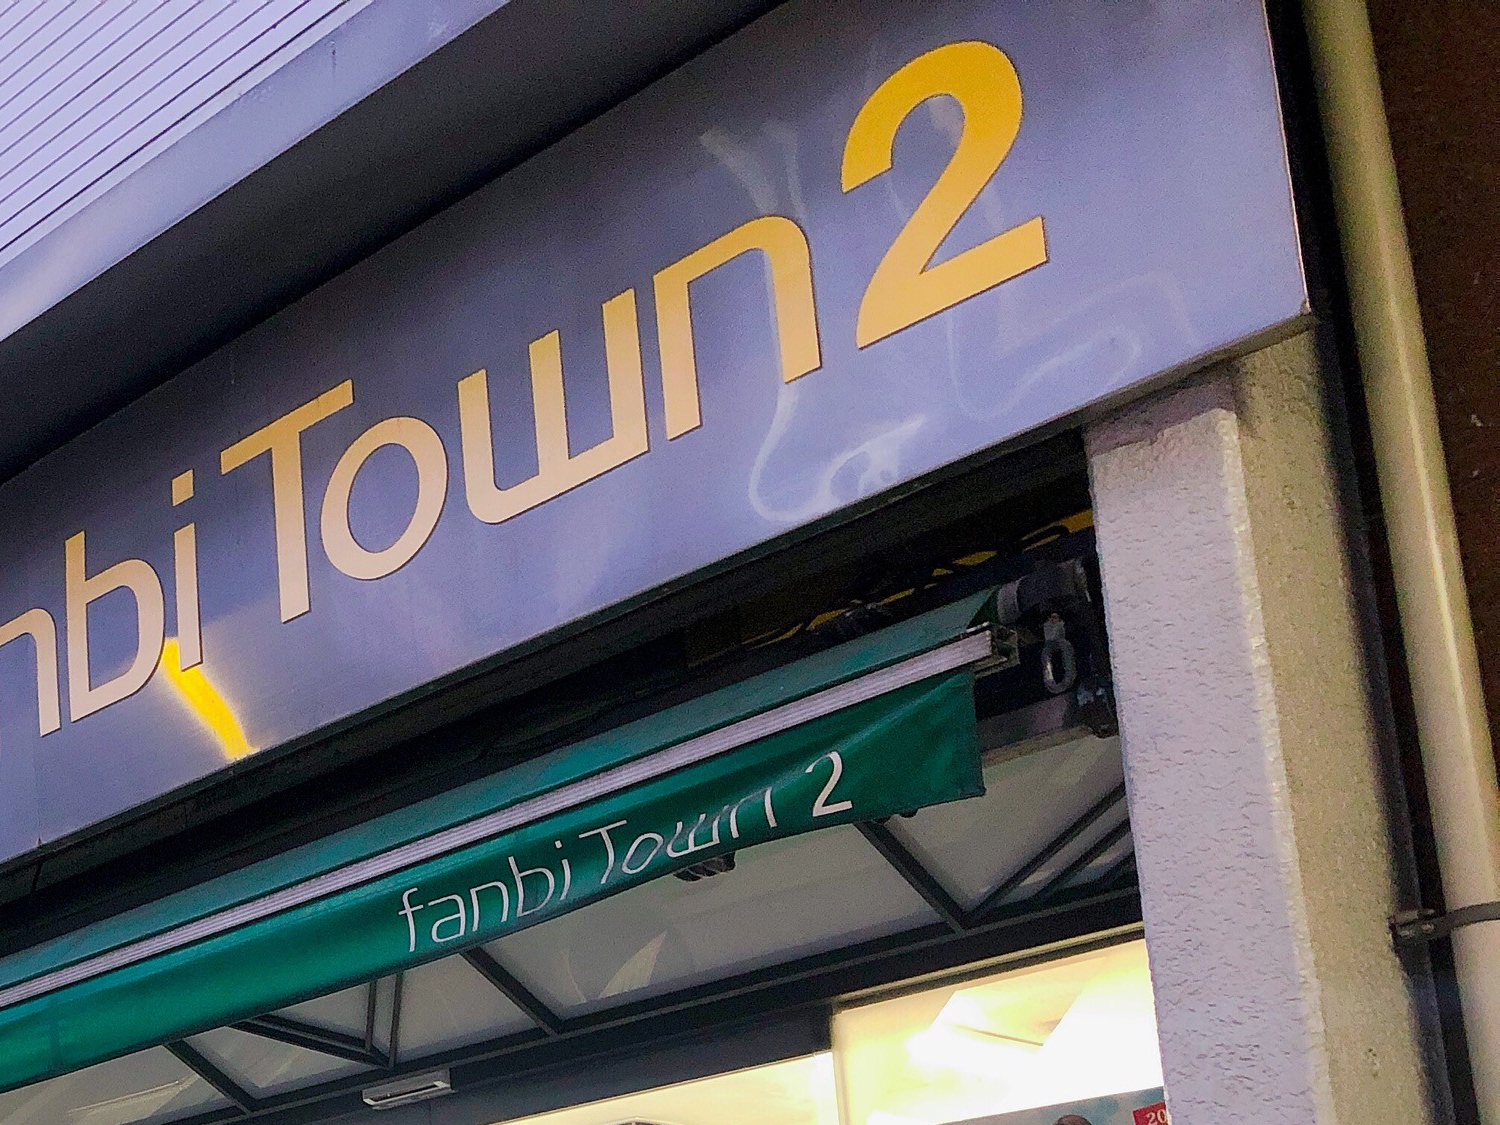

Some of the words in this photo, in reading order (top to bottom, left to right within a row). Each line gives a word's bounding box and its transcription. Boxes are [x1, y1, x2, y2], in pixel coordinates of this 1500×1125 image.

[221, 214, 822, 625] Town
[840, 40, 1049, 350] 2
[399, 840, 571, 952] fanbi
[579, 787, 778, 884] Town
[805, 751, 853, 818] 2
